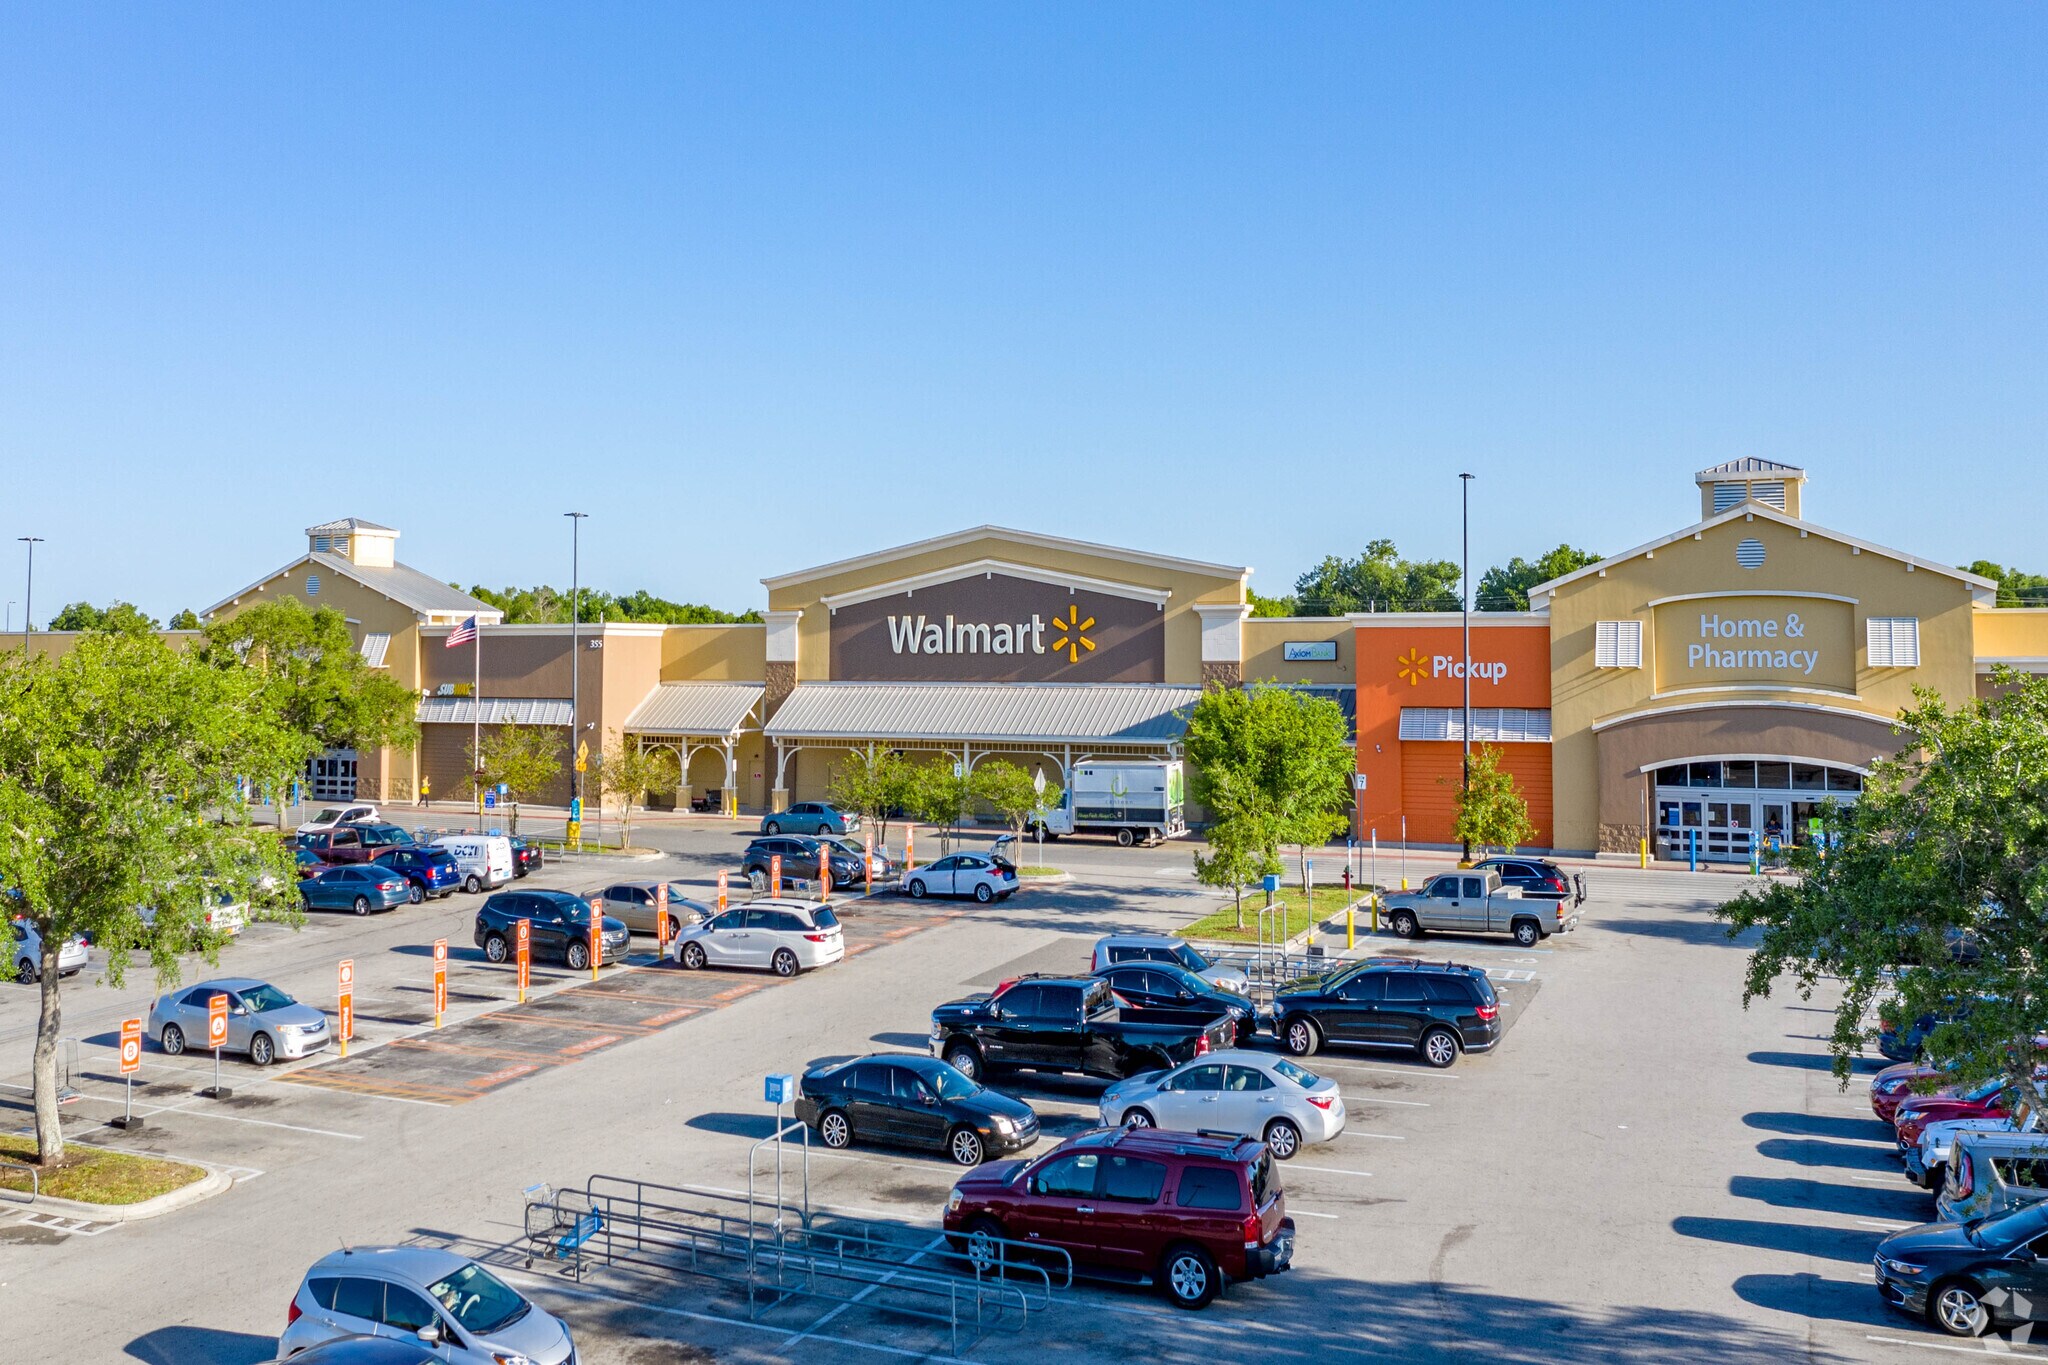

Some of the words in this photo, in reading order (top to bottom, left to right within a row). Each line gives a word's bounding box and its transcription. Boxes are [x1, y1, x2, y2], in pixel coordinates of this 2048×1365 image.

[887, 614, 1046, 655] Walmart
[1700, 614, 1778, 638] Home
[1784, 613, 1805, 638] &
[590, 639, 603, 649] 355
[1688, 643, 1819, 675] Pharmacy
[1433, 655, 1508, 685] Pickup
[437, 682, 476, 697] SUBWAY
[215, 1021, 222, 1032] A
[128, 1045, 134, 1057] B
